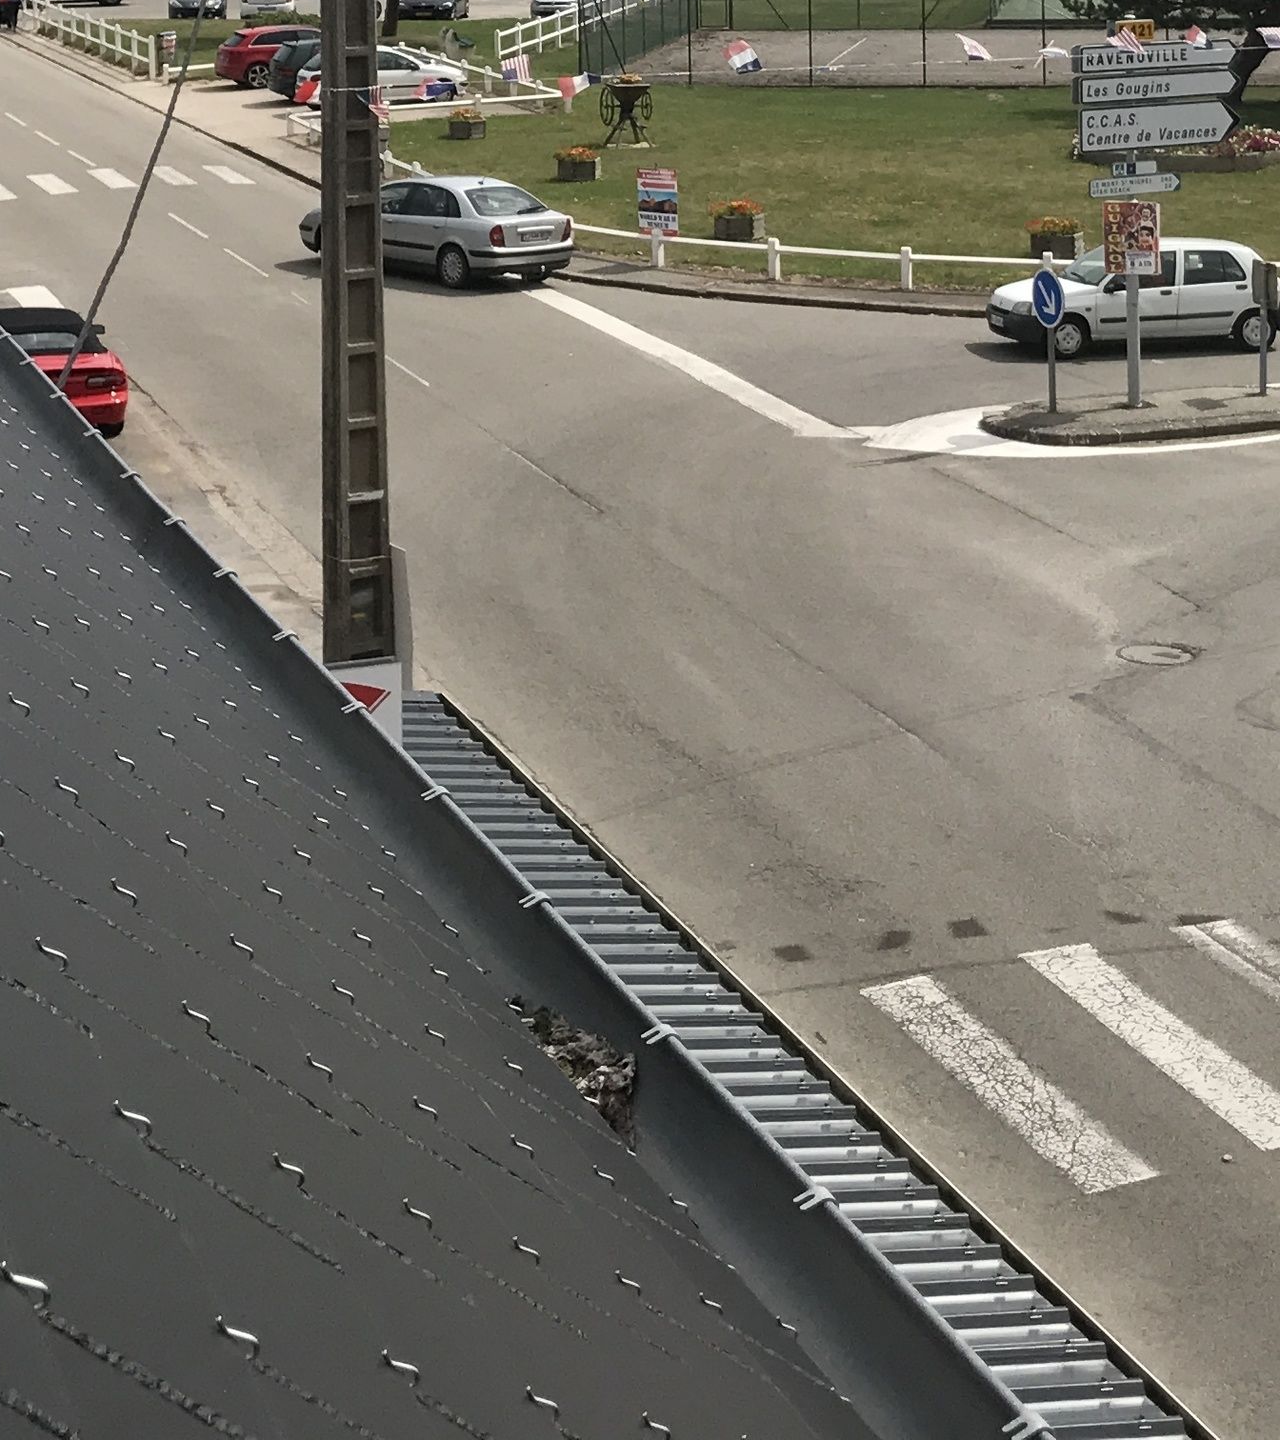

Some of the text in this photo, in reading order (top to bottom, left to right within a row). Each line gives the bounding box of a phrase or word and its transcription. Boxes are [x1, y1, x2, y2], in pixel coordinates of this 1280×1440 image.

[1086, 48, 1188, 67] RAVENOVILLE
[1087, 82, 1171, 98] Les Gougins
[1086, 113, 1139, 129] C.C.A.S.
[1087, 127, 1217, 146] Centre de Vacances
[1107, 203, 1123, 273] GUIGNOL
